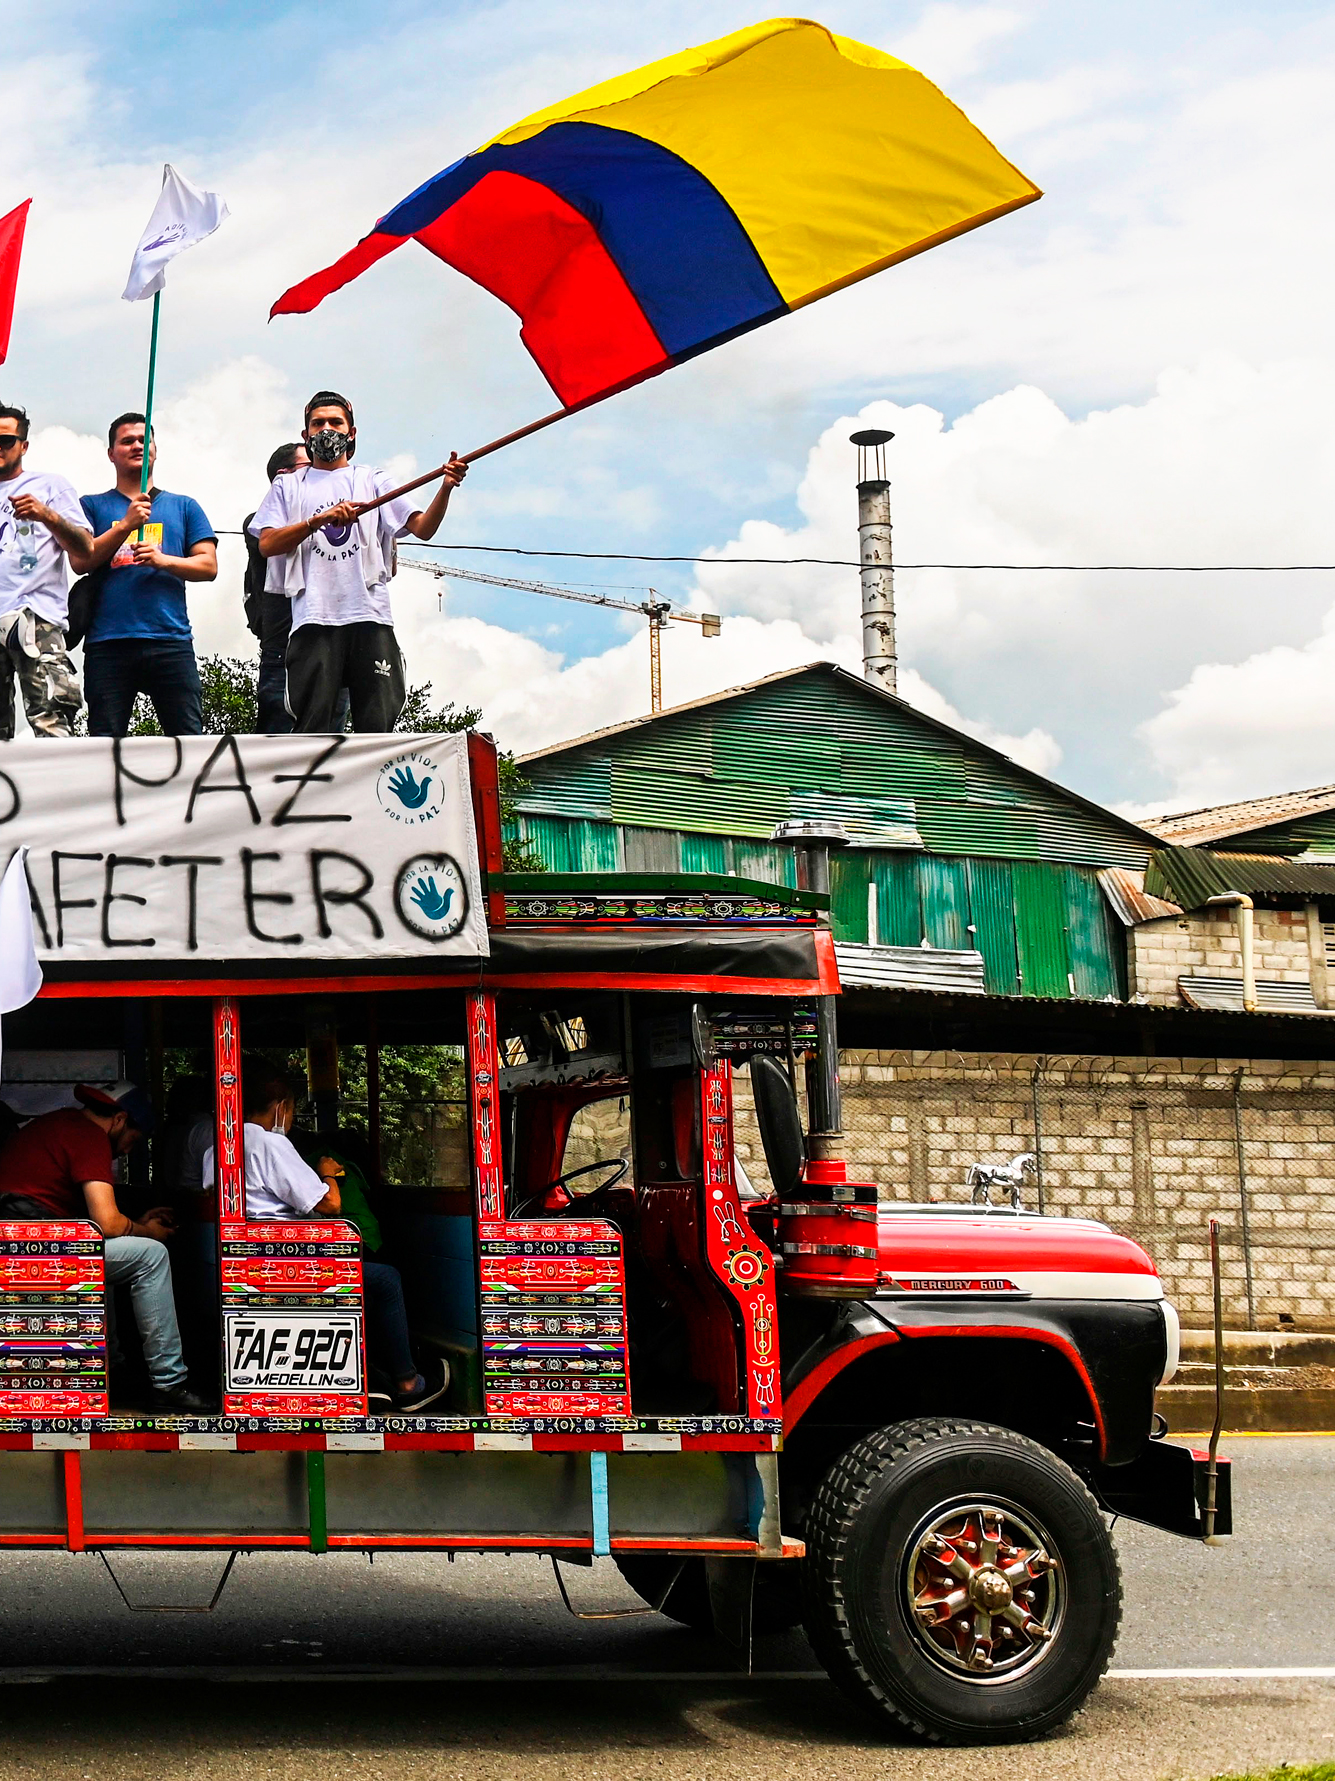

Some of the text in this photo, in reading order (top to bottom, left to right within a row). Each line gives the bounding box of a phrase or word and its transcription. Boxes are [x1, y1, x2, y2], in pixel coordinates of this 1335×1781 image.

[341, 543, 360, 560] PAZ
[380, 752, 438, 774] POR LA VIDA
[111, 734, 351, 826] PAZ
[385, 805, 440, 825] POR LA PAZ
[418, 865, 429, 873] LA
[910, 1280, 1004, 1290] MERCURY 600
[233, 1328, 354, 1370] TAF 920
[236, 1376, 251, 1384] Ford
[254, 1373, 334, 1386] MEDELLIN
